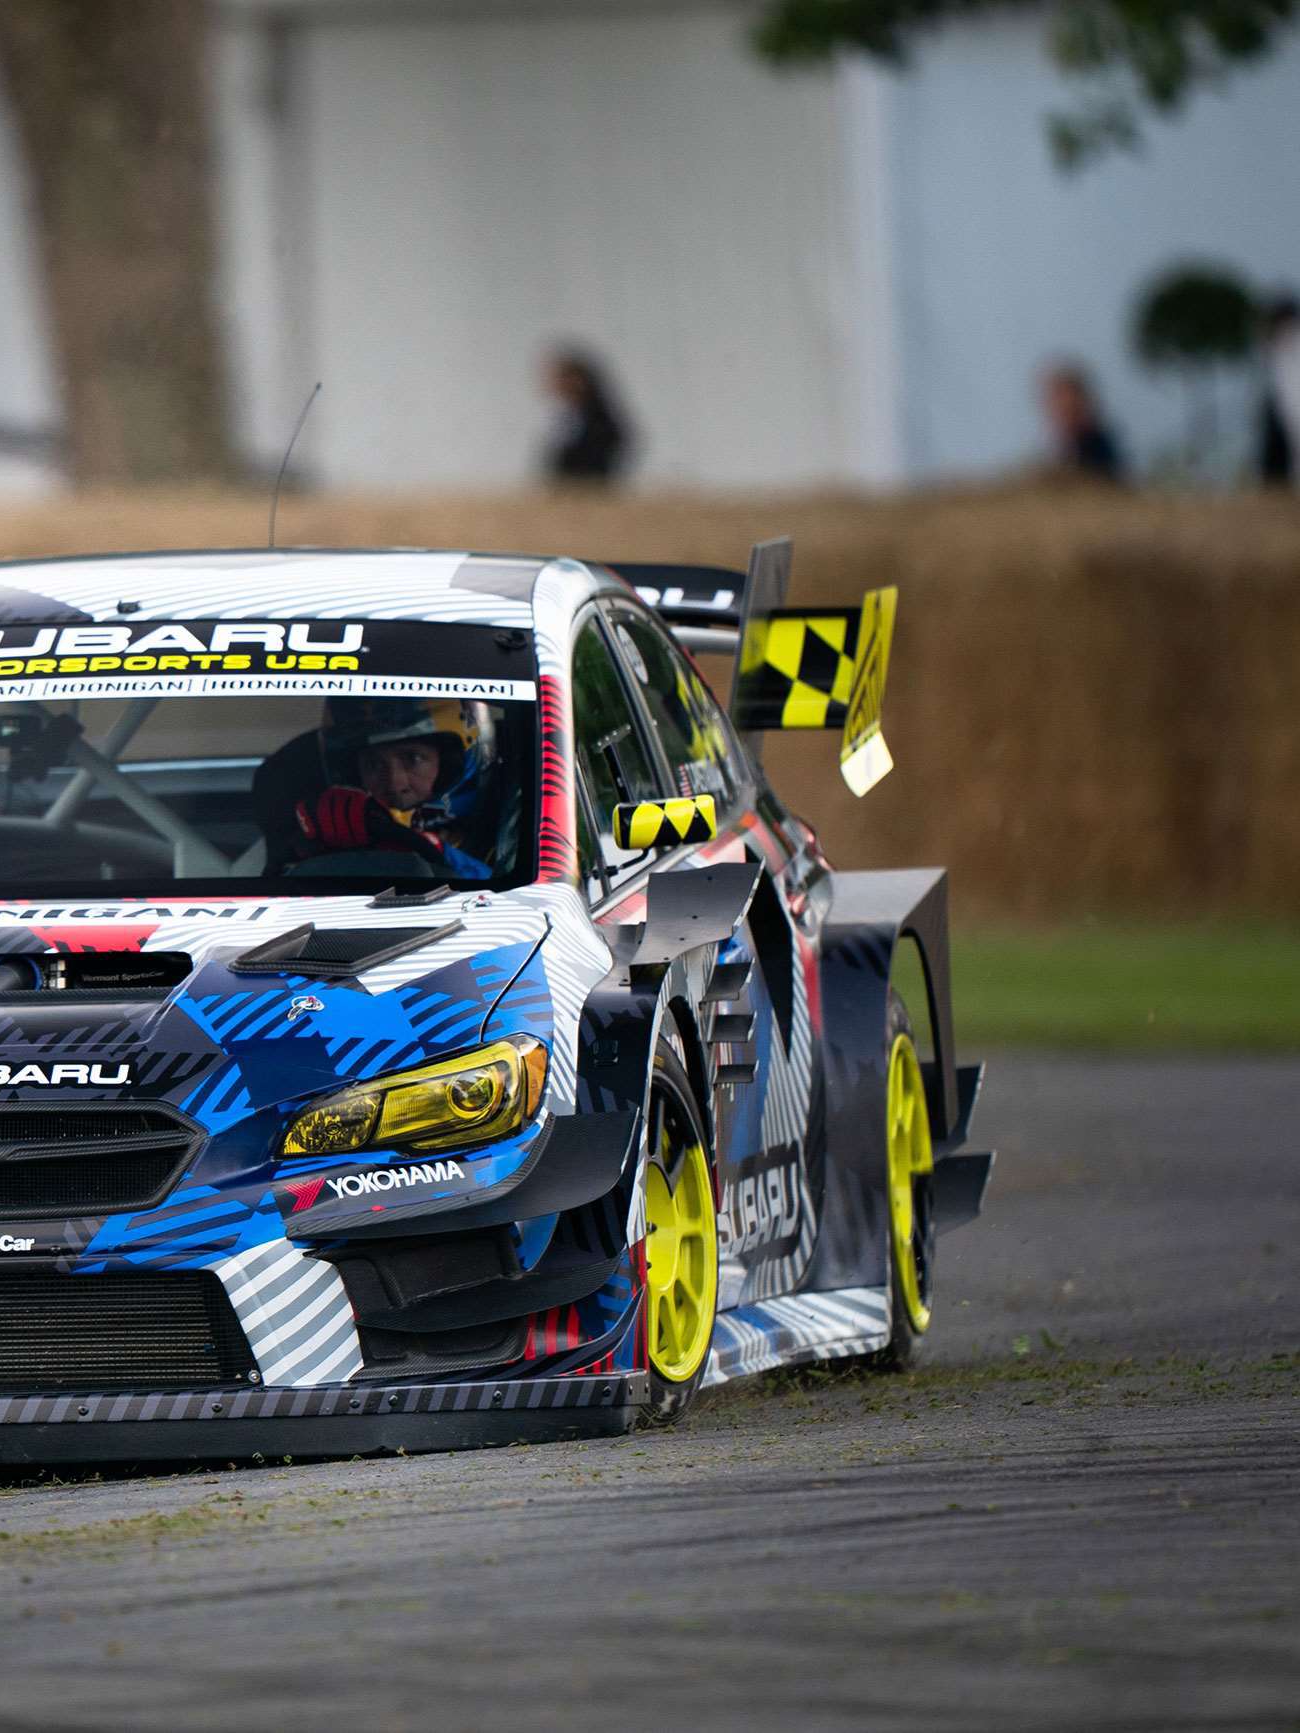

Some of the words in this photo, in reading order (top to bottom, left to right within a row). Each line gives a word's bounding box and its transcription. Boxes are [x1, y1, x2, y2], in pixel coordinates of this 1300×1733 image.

[265, 654, 360, 671] USA
[326, 1160, 466, 1200] YOKOHAMA
[717, 1162, 800, 1253] SUBARU
